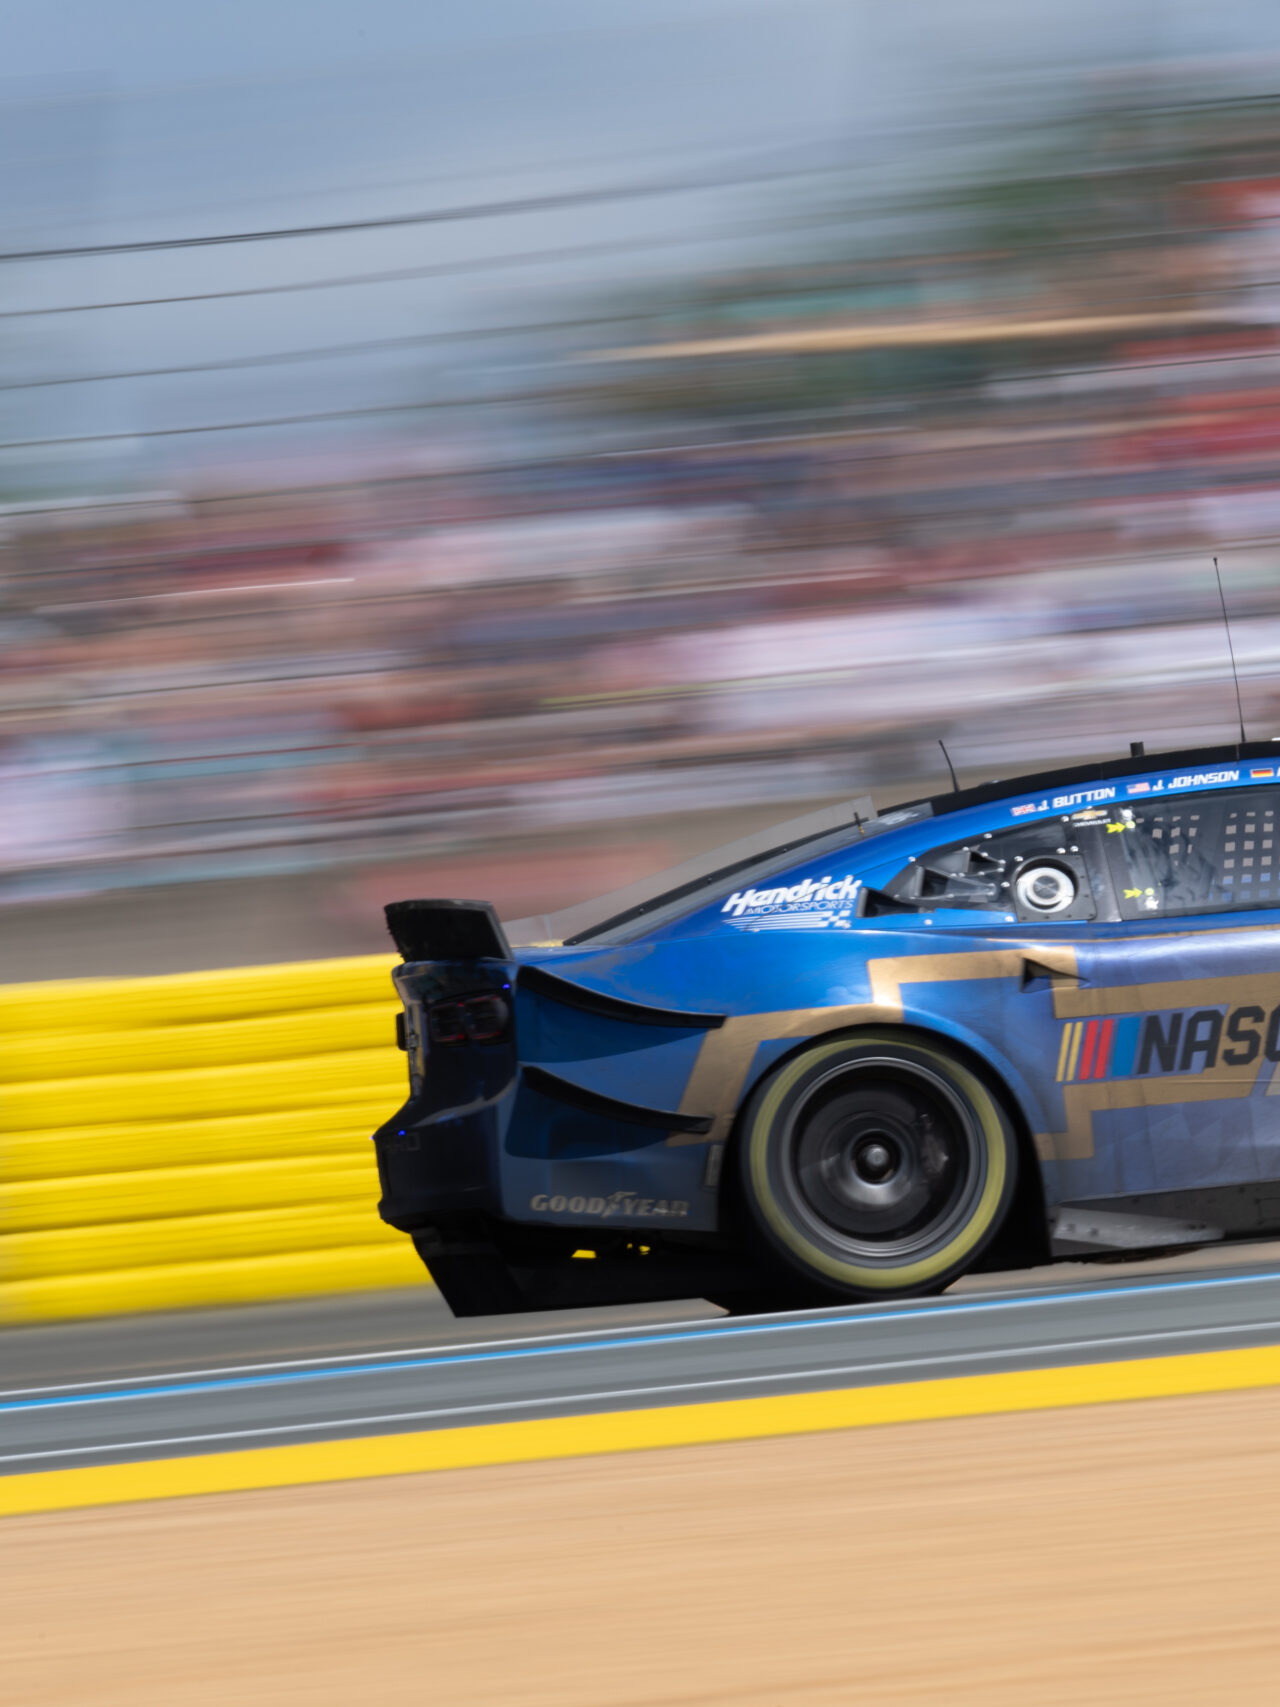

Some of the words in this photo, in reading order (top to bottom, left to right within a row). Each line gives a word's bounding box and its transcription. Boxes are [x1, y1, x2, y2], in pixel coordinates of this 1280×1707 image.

[1152, 780, 1164, 791] J.
[1168, 770, 1239, 789] JOHNSON
[1037, 800, 1050, 811] J.
[1052, 786, 1116, 808] BUTTON
[720, 874, 862, 916] Hendrick
[743, 899, 855, 915] MOTORSPORTS
[530, 1191, 690, 1219] GOODYEAR
